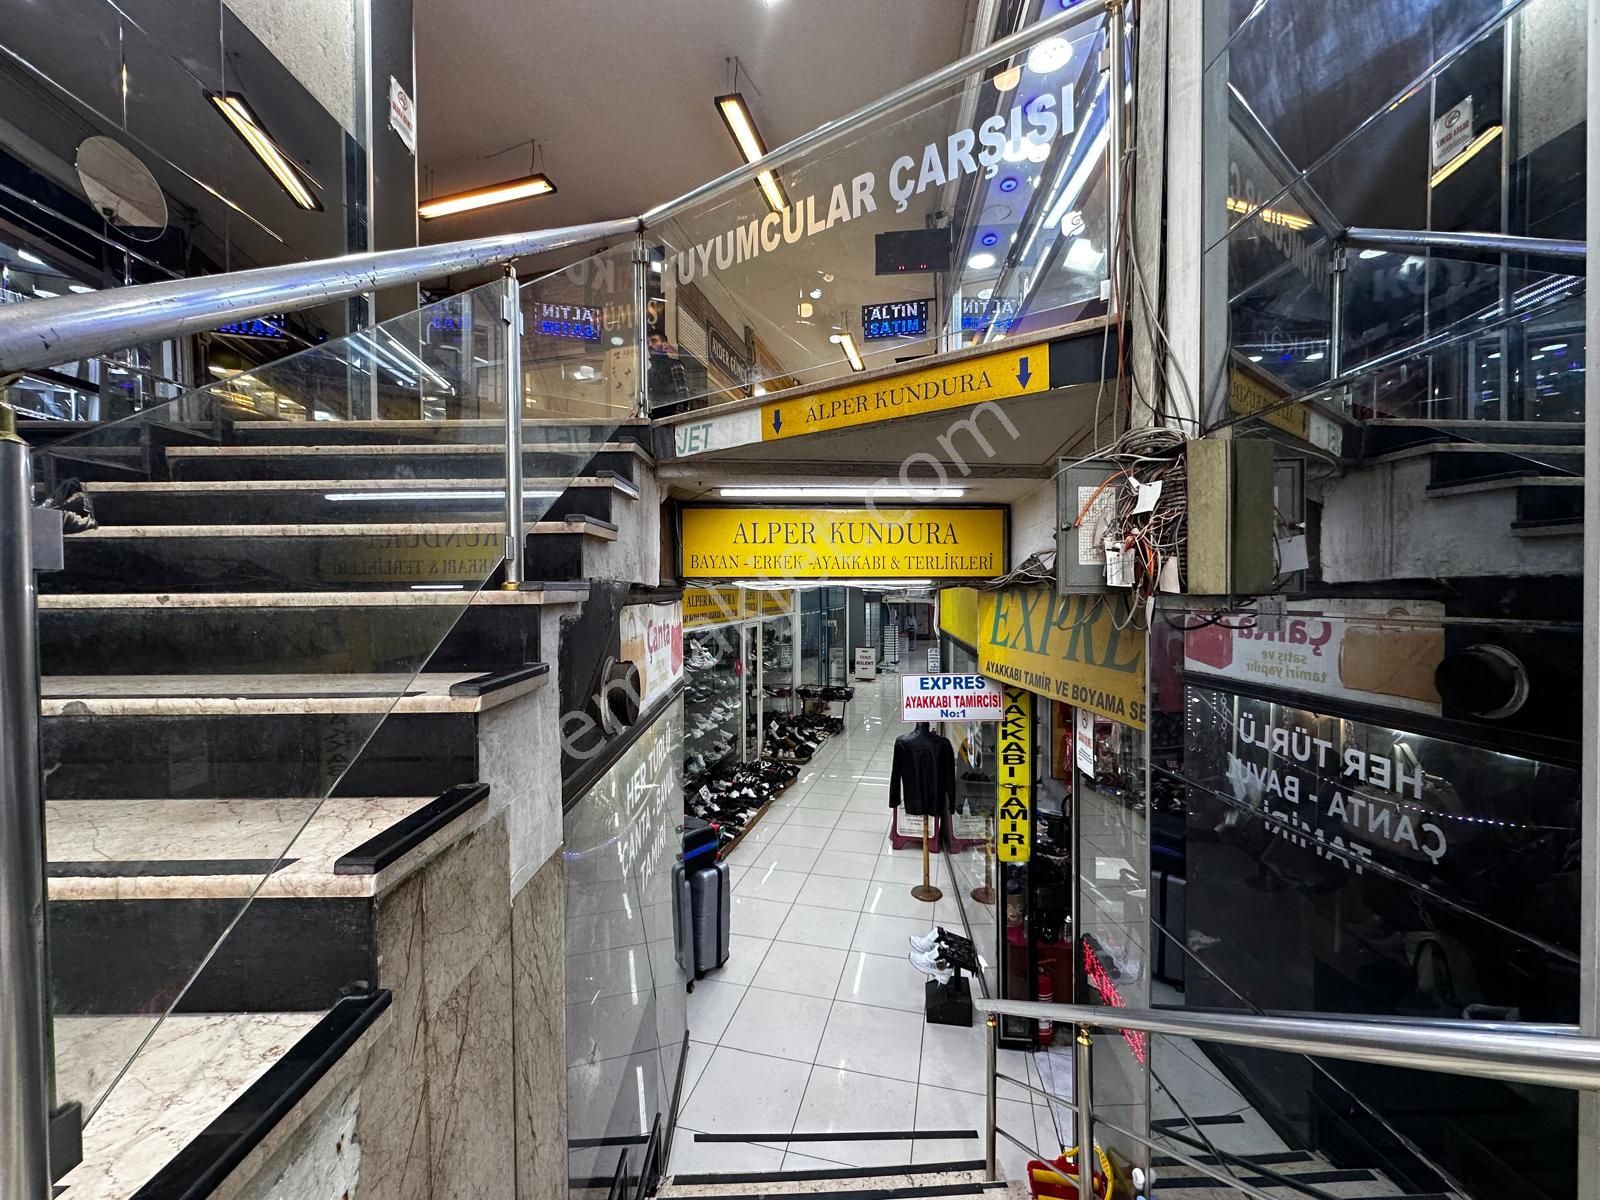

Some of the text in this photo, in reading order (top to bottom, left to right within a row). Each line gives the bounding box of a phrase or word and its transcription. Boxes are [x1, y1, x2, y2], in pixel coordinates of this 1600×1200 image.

[888, 82, 1075, 214] ÇARŞISI
[871, 302, 918, 321] ALTIN
[805, 369, 994, 424] ALPER KUNDURA
[677, 422, 713, 454] JET
[732, 522, 959, 545] ALPER KUNDURA
[690, 555, 740, 570] BAYAN
[753, 555, 803, 570] ERKEK
[890, 557, 900, 570] &
[905, 553, 993, 571] TERLİKLERİ
[646, 618, 671, 665] Çanta
[919, 675, 986, 691] EXPRES
[986, 660, 1022, 682] AYAKKABI
[1023, 671, 1051, 693] TAMİR
[1055, 680, 1069, 698] VE
[1072, 684, 1126, 717] BOYAMA
[905, 691, 1001, 709] AYAKKABI TAMİRCİSİ
[940, 709, 967, 719] No:1
[1000, 688, 1027, 778] YAKKABI
[625, 762, 647, 816] HER
